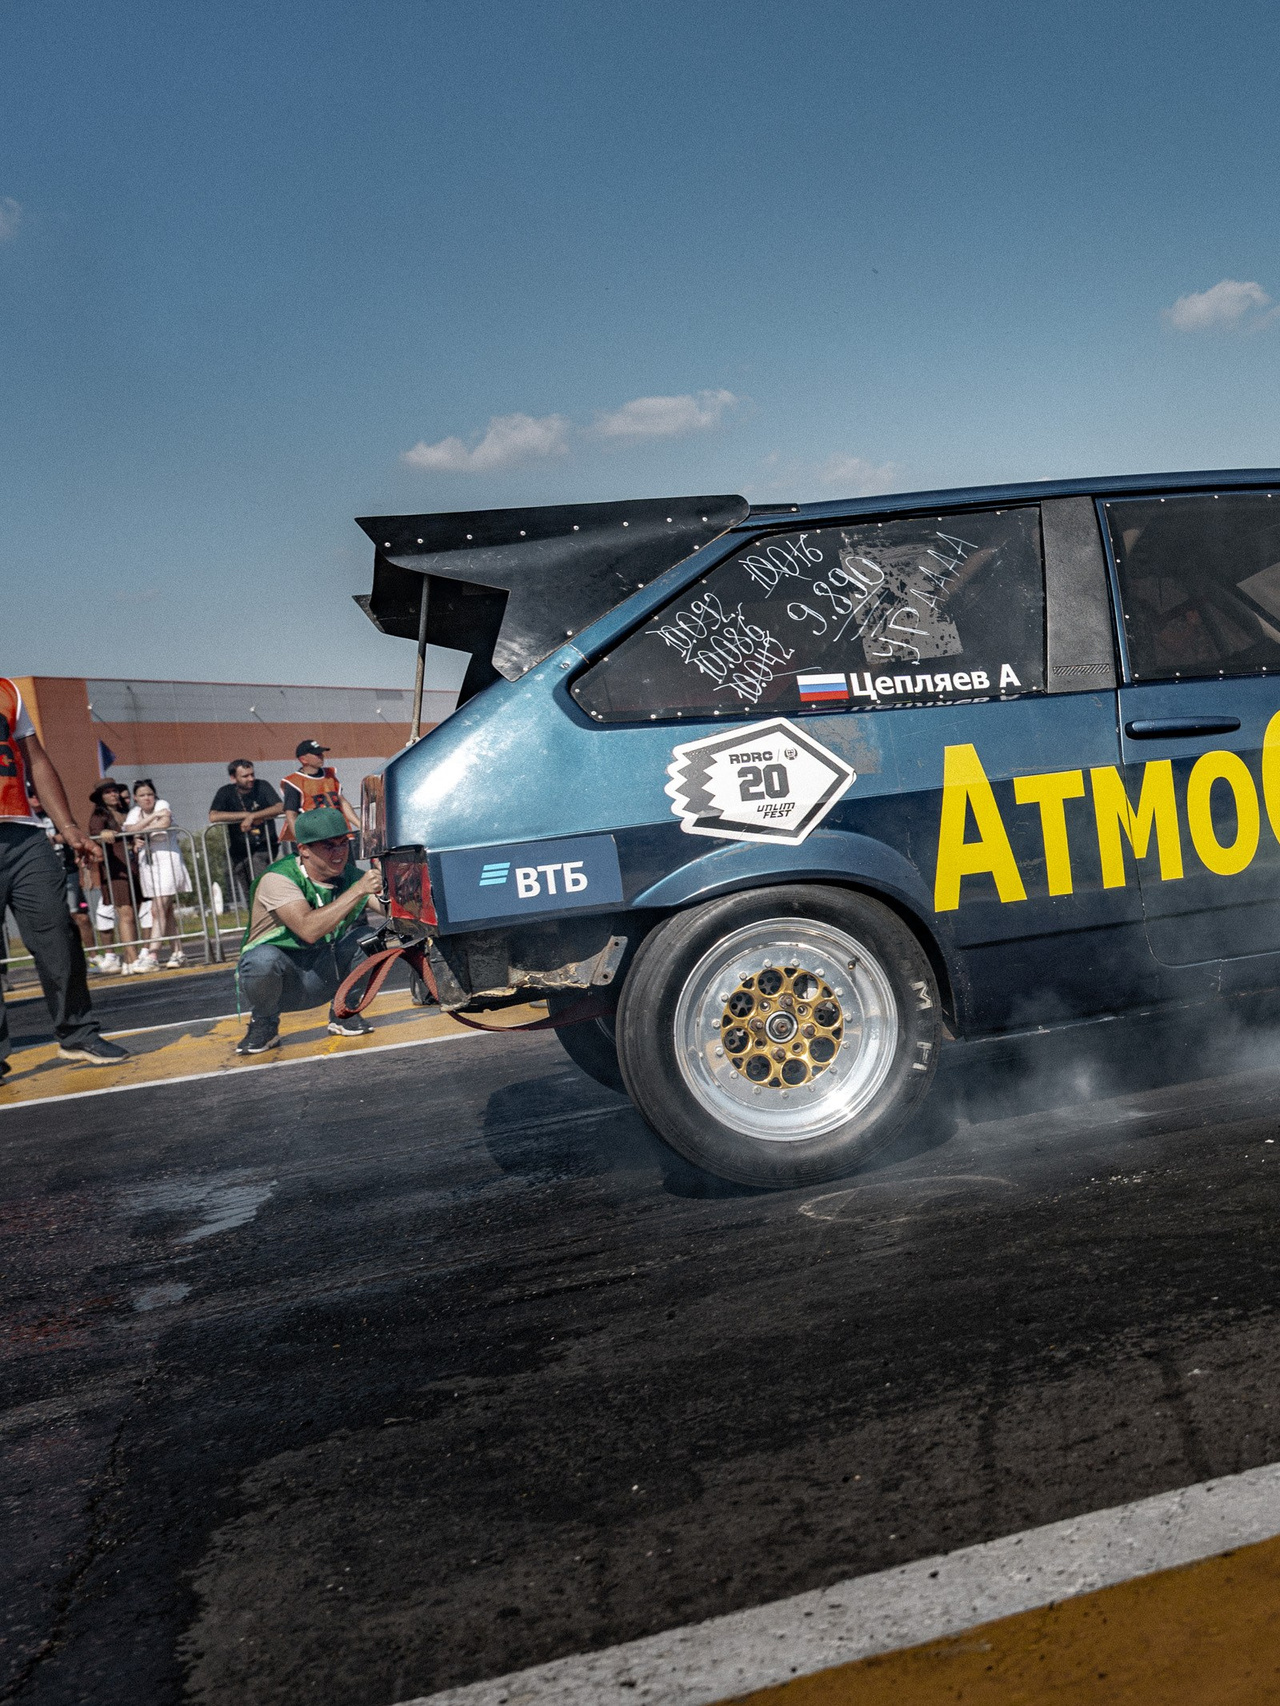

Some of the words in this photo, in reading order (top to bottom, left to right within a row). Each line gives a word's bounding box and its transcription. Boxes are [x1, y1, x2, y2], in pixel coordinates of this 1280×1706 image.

[787, 556, 885, 636] 9.890
[849, 670, 990, 700] Цепляев
[999, 663, 1022, 688] А
[729, 751, 774, 765] RDRC
[737, 763, 791, 802] 20
[757, 802, 796, 813] UNLIM
[763, 810, 792, 819] FEST
[515, 860, 588, 899] ВТБ
